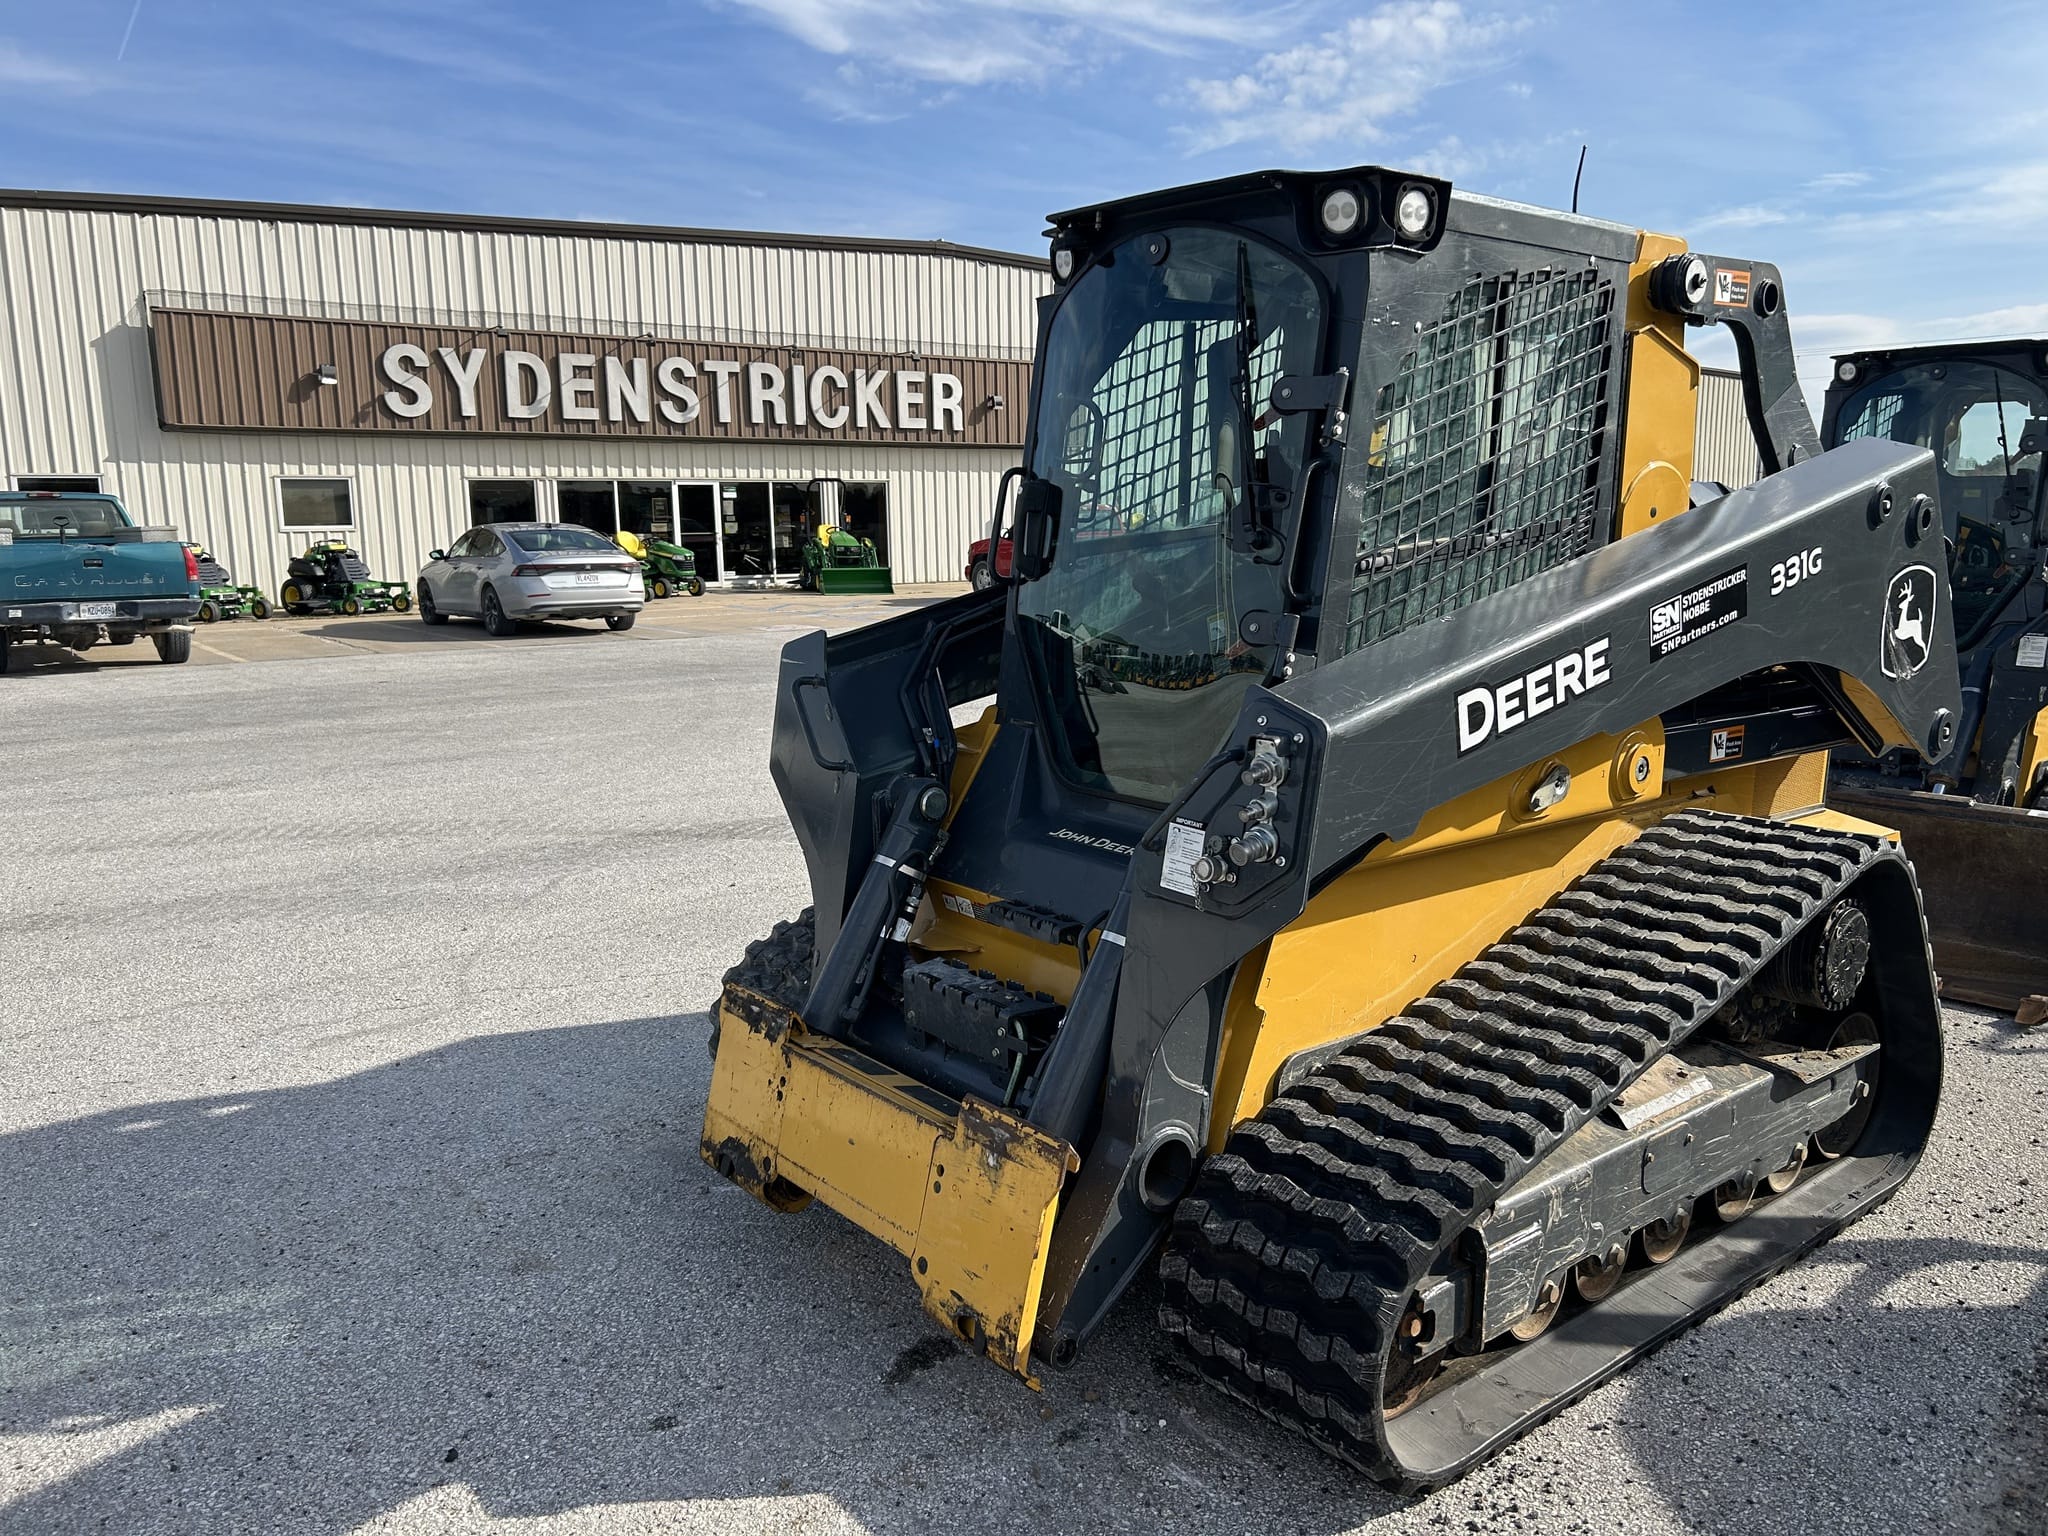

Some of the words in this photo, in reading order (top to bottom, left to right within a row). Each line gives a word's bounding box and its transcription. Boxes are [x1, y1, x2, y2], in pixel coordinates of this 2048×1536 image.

[382, 343, 964, 432] SYDENSTRICKER
[1682, 569, 1747, 608] SYDENSTRICKER
[1770, 546, 1823, 596] 331G
[1652, 600, 1680, 632] SN
[1682, 599, 1711, 623] NOBBE
[1652, 623, 1680, 642] PARTNERS
[1661, 609, 1738, 655] SNPartners.com
[1457, 637, 1611, 752] DEERE
[1048, 828, 1096, 845] JOHN
[1175, 816, 1204, 829] IMPORTANT
